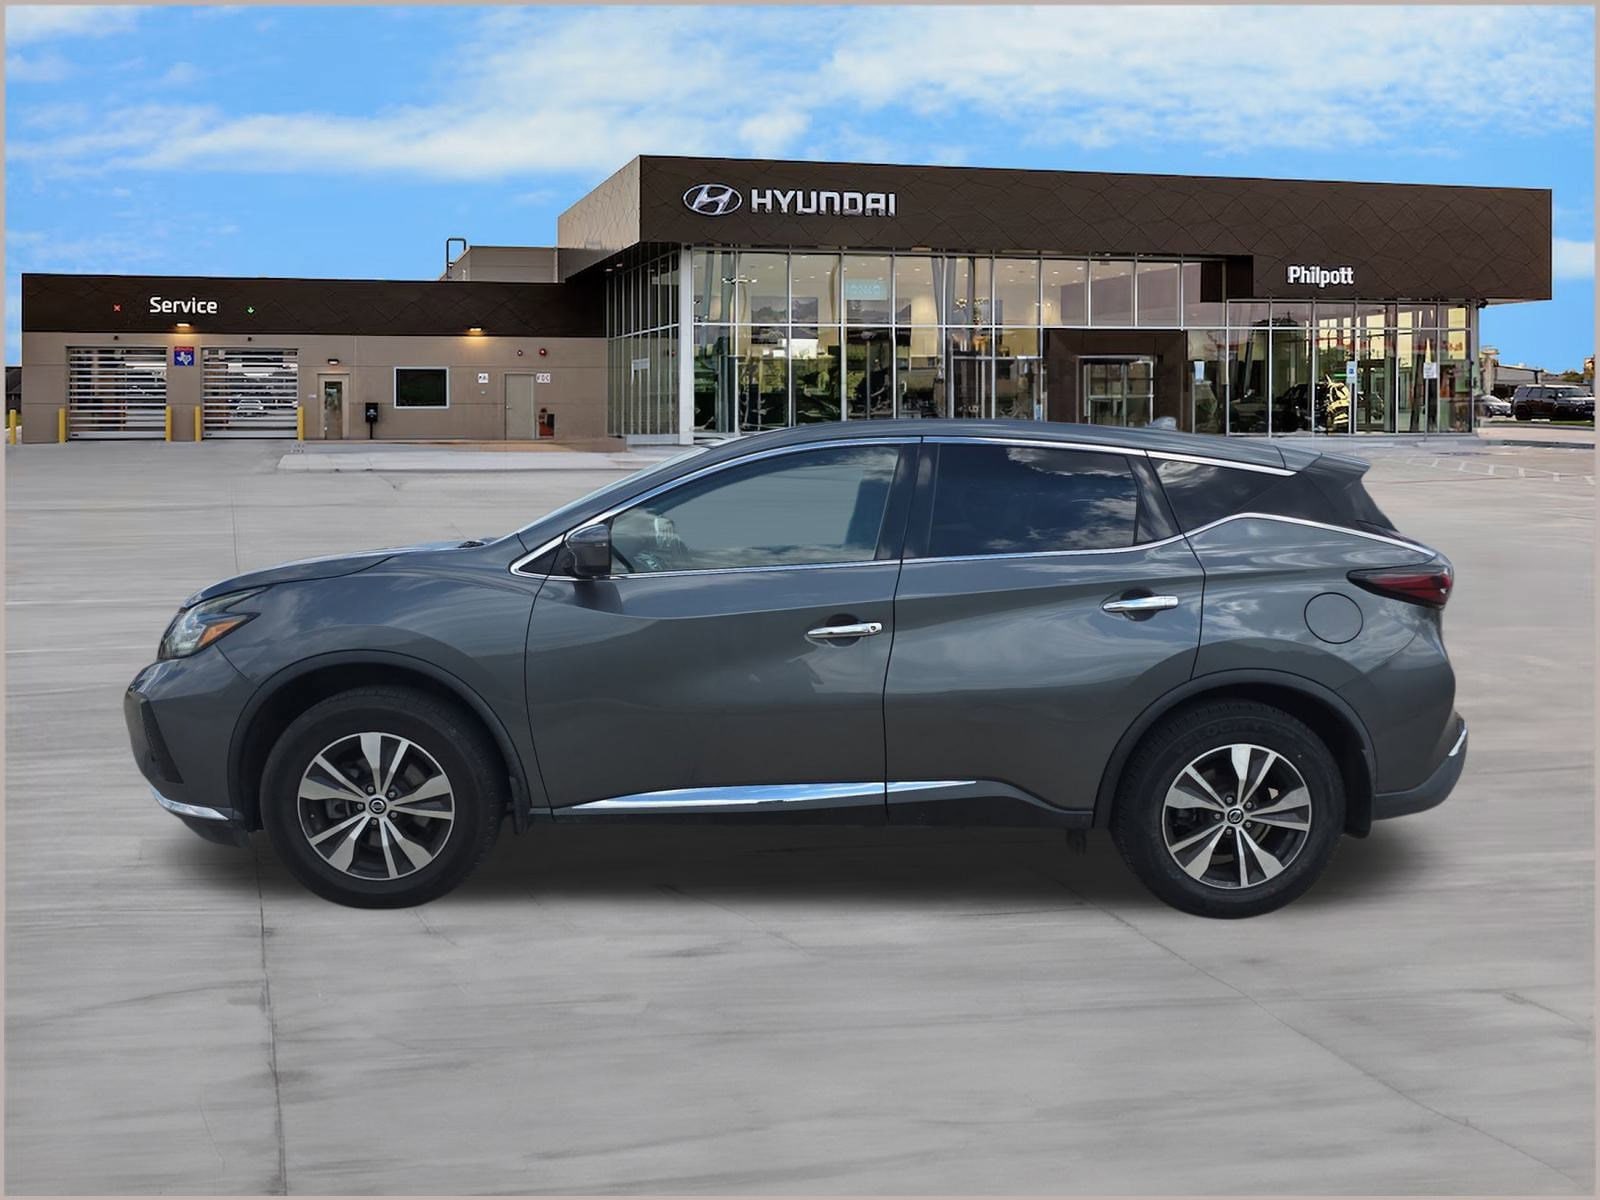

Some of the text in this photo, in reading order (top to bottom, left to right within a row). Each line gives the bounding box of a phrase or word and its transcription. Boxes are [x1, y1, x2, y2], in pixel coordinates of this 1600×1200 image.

[751, 188, 896, 217] HYUNDAI
[1287, 265, 1355, 288] Philpott
[149, 296, 218, 314] Service
